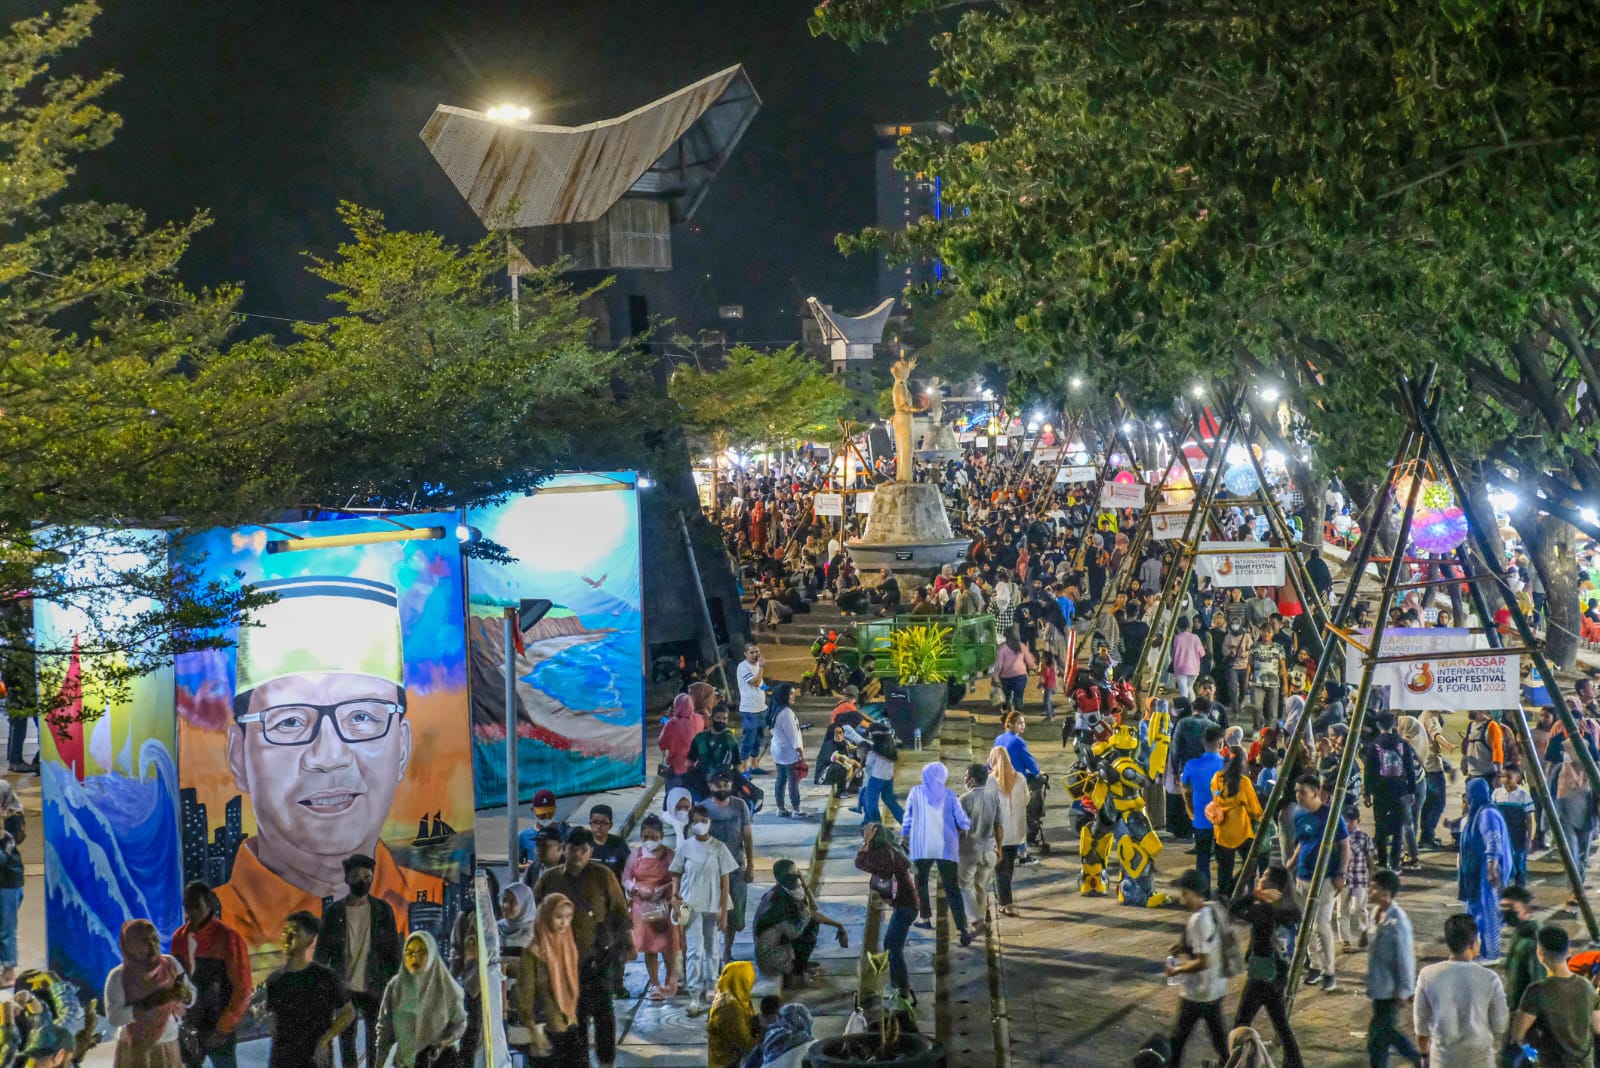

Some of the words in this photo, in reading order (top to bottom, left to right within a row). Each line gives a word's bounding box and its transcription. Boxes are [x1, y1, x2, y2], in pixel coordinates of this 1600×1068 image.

[1437, 667, 1506, 676] INTERNATIONAL
[1437, 675, 1463, 684] EIGHT
[1465, 674, 1506, 683] FESTIVAL
[1437, 684, 1443, 692] &
[1446, 684, 1482, 692] FORUM
[1484, 683, 1506, 692] 2022
